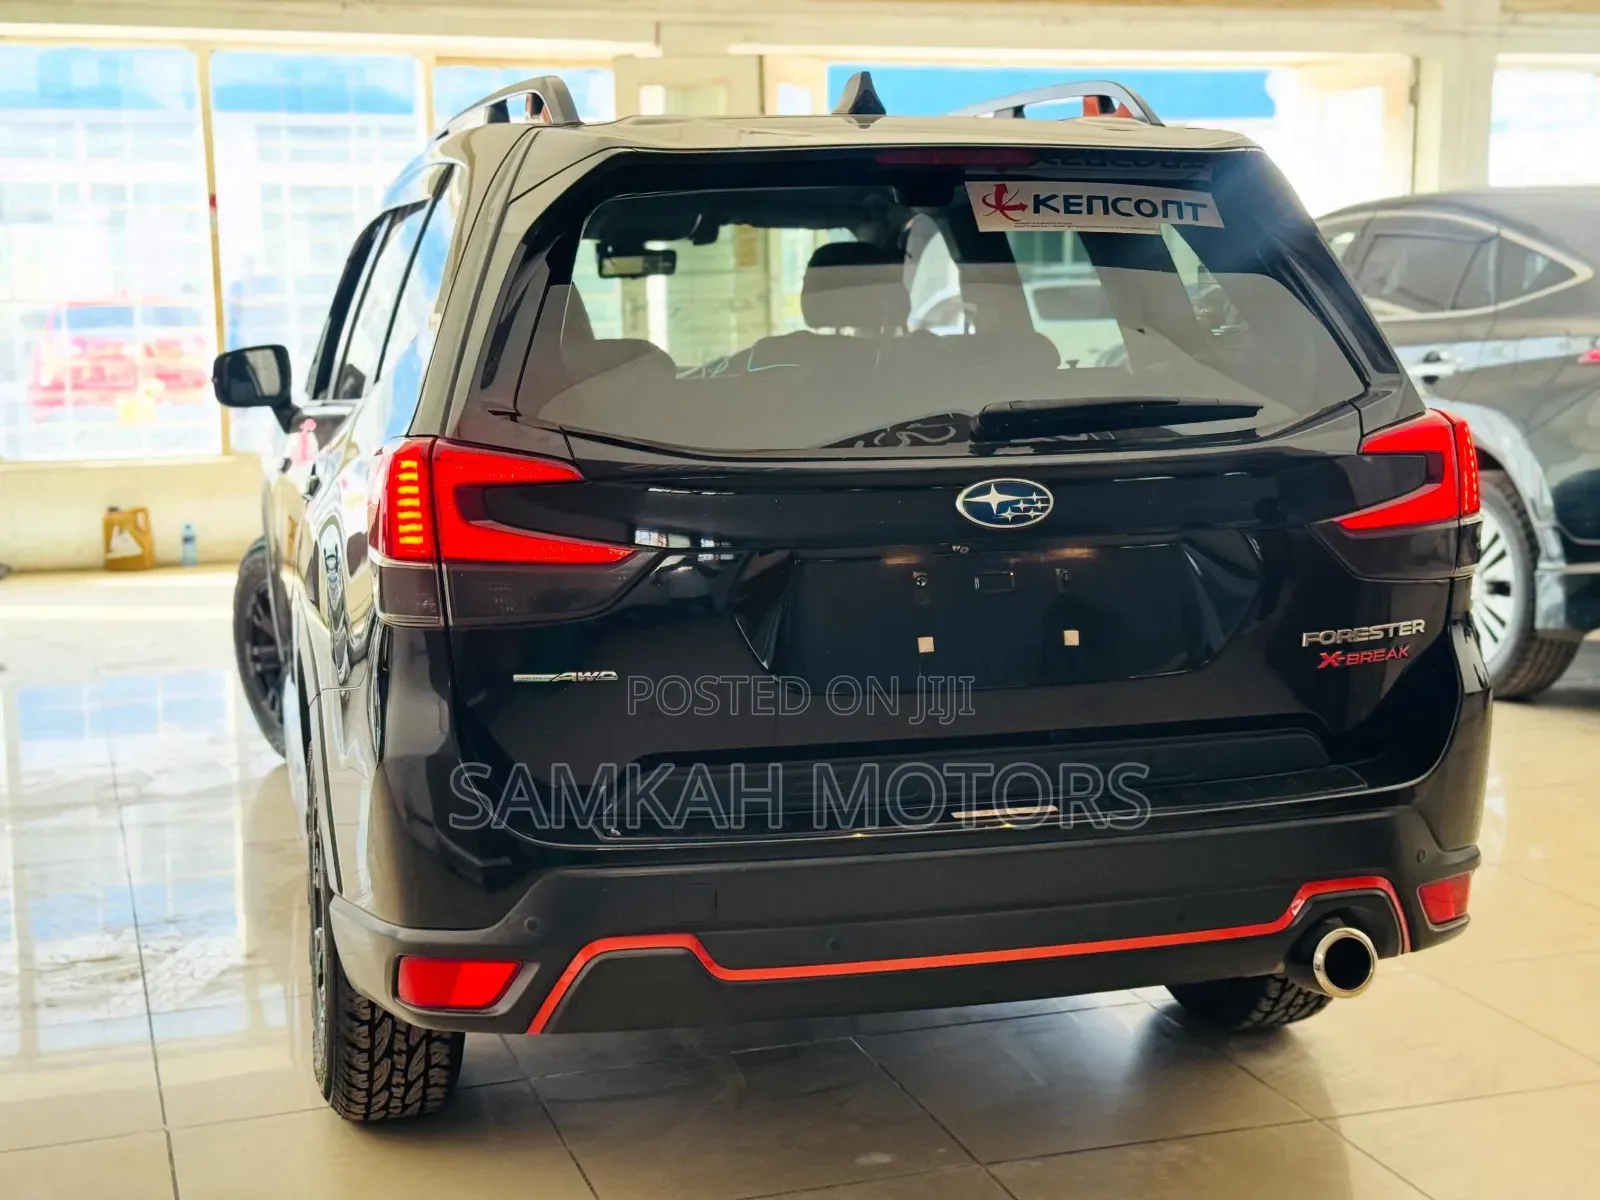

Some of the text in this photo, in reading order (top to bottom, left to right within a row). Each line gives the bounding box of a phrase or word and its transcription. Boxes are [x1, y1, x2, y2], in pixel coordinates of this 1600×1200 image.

[1302, 619, 1426, 647] FORESTER
[1318, 646, 1410, 669] X-BREAK
[552, 671, 619, 682] AWD
